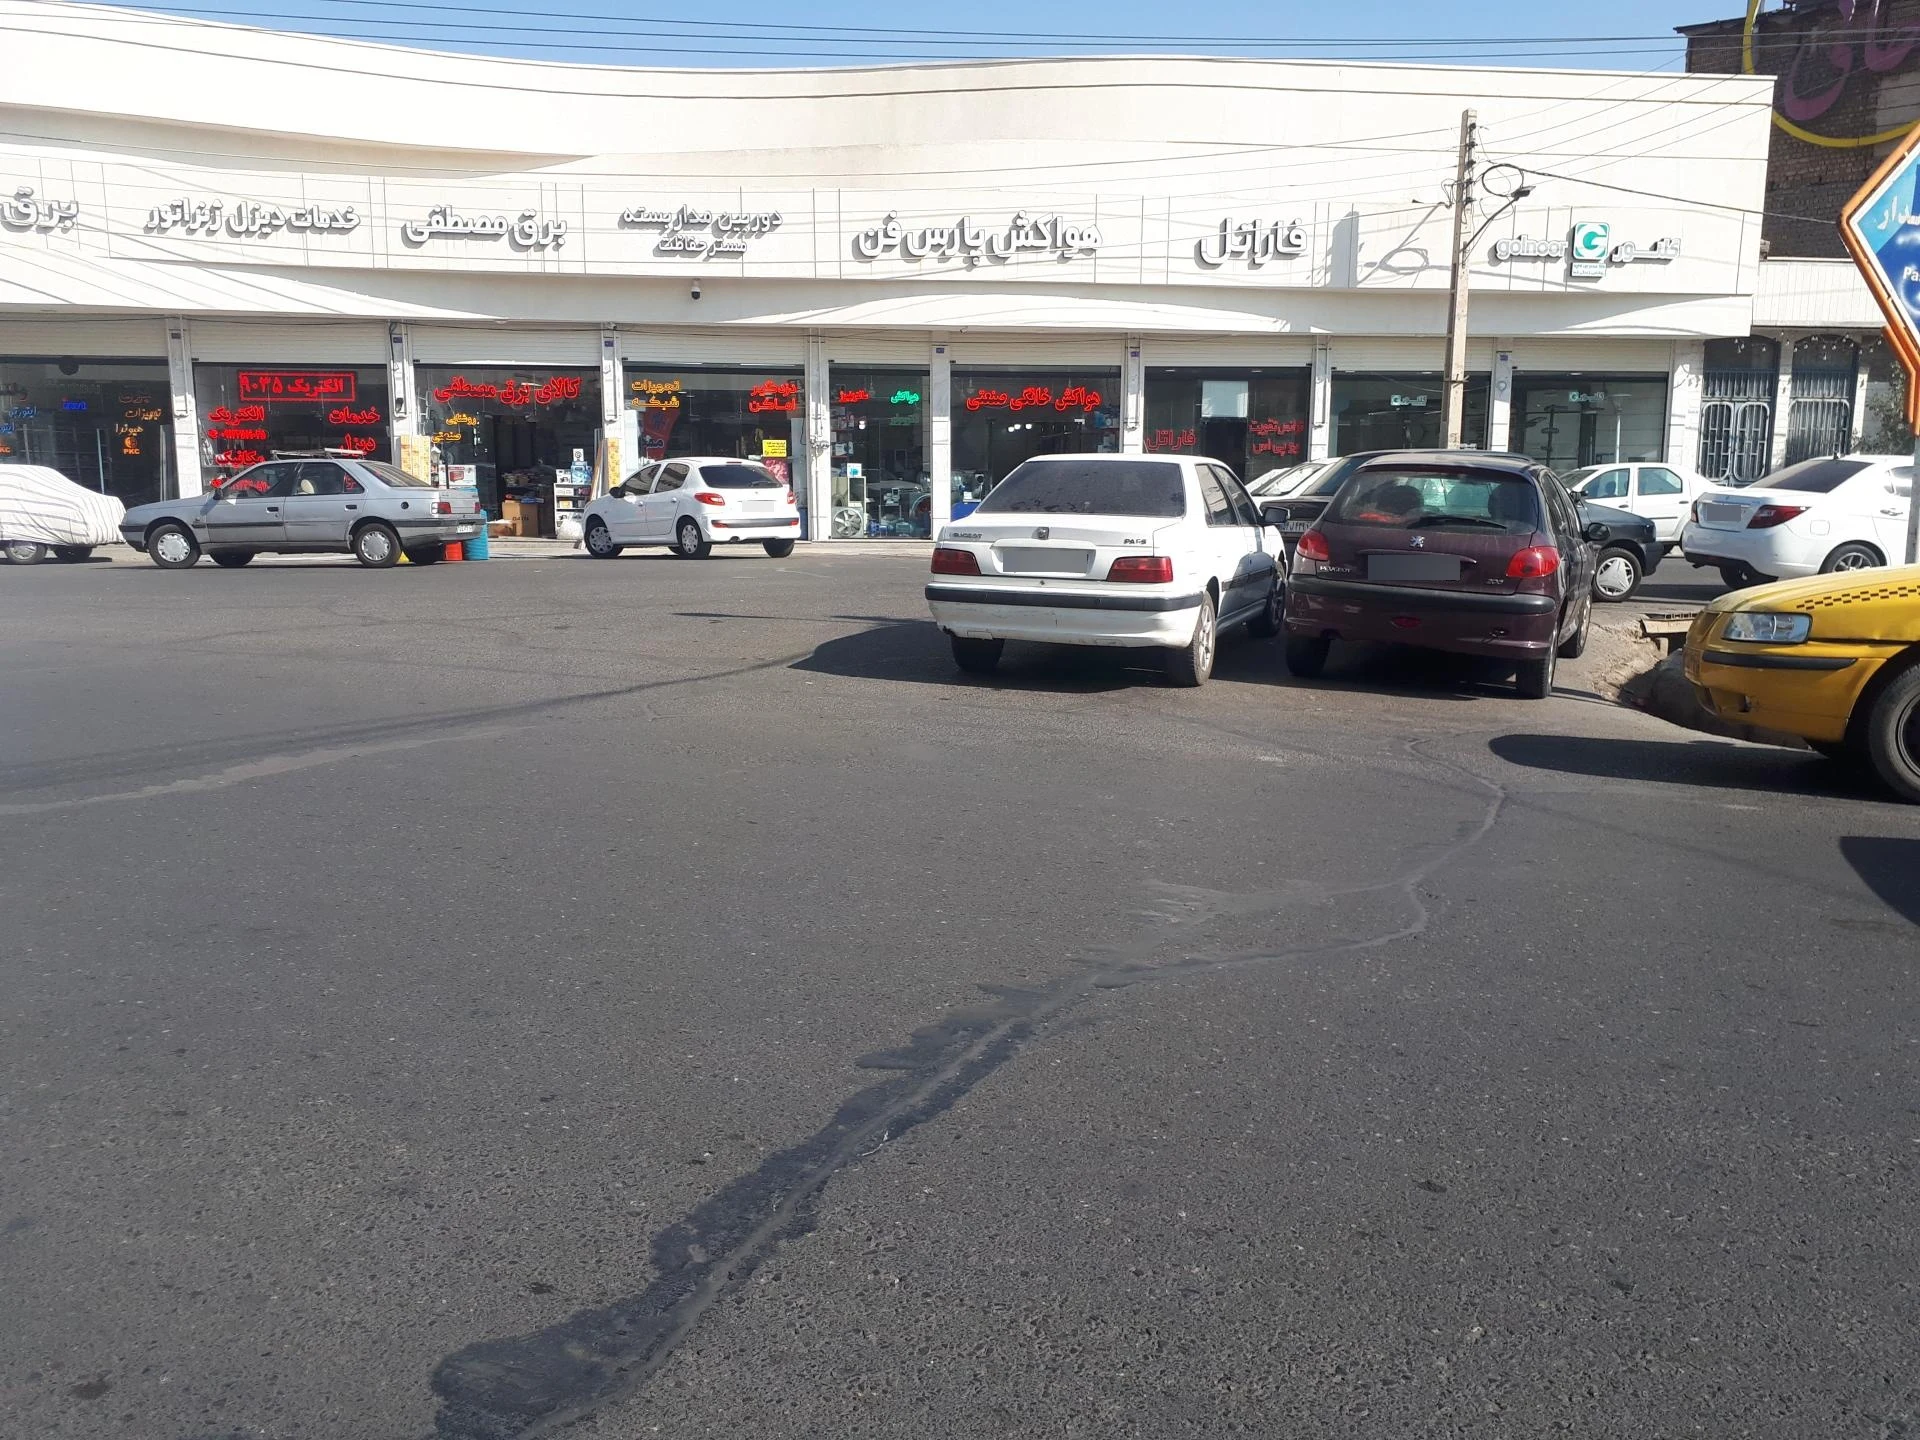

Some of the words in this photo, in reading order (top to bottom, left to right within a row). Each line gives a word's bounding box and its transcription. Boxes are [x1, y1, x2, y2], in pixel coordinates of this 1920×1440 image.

[1, 186, 79, 229] برق
[145, 197, 223, 232] ژنراتور
[229, 201, 286, 234] دیزل
[290, 205, 361, 230] خدمات
[404, 204, 509, 243] مصطفی
[512, 208, 568, 246] برق
[858, 209, 903, 257] فن
[992, 209, 1104, 258] هواکش
[657, 236, 706, 255] حفاظت
[906, 215, 986, 267] پارس
[1200, 217, 1308, 265] فاراتل
[1496, 234, 1568, 260] golnoor
[1903, 266, 1920, 281] Pa
[287, 378, 345, 396] الکتریک
[433, 375, 498, 403] مصطفی
[500, 378, 531, 405] برق
[534, 376, 583, 404] کالای
[632, 379, 681, 393] تجهیزات
[1009, 387, 1052, 411] خانگی
[632, 396, 680, 411] شبکه
[748, 397, 797, 413] اماکن
[966, 390, 1008, 411] صنعتی
[1054, 387, 1102, 412] هواکش
[208, 405, 266, 426] الکتریک
[328, 406, 381, 425] خدمات
